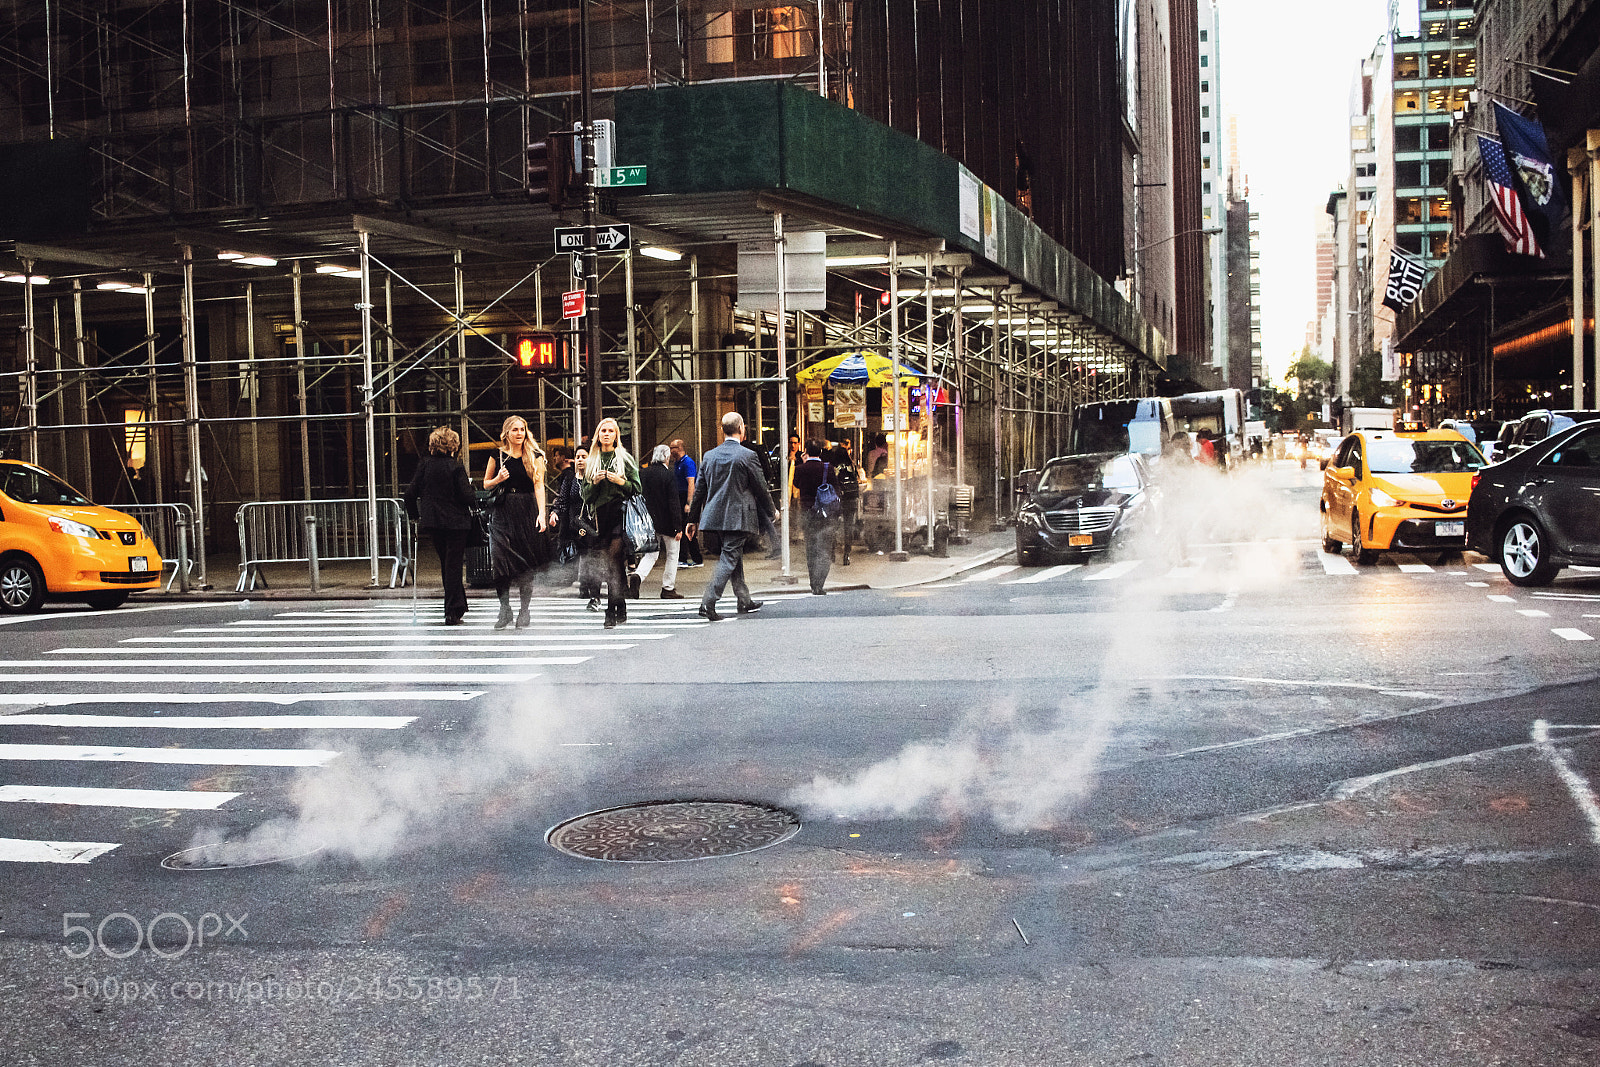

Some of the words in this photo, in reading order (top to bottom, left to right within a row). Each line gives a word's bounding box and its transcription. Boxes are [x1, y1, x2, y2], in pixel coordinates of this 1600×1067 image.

[616, 169, 626, 184] 5
[629, 168, 641, 177] AV
[566, 234, 585, 246] ON
[597, 233, 618, 244] WAY
